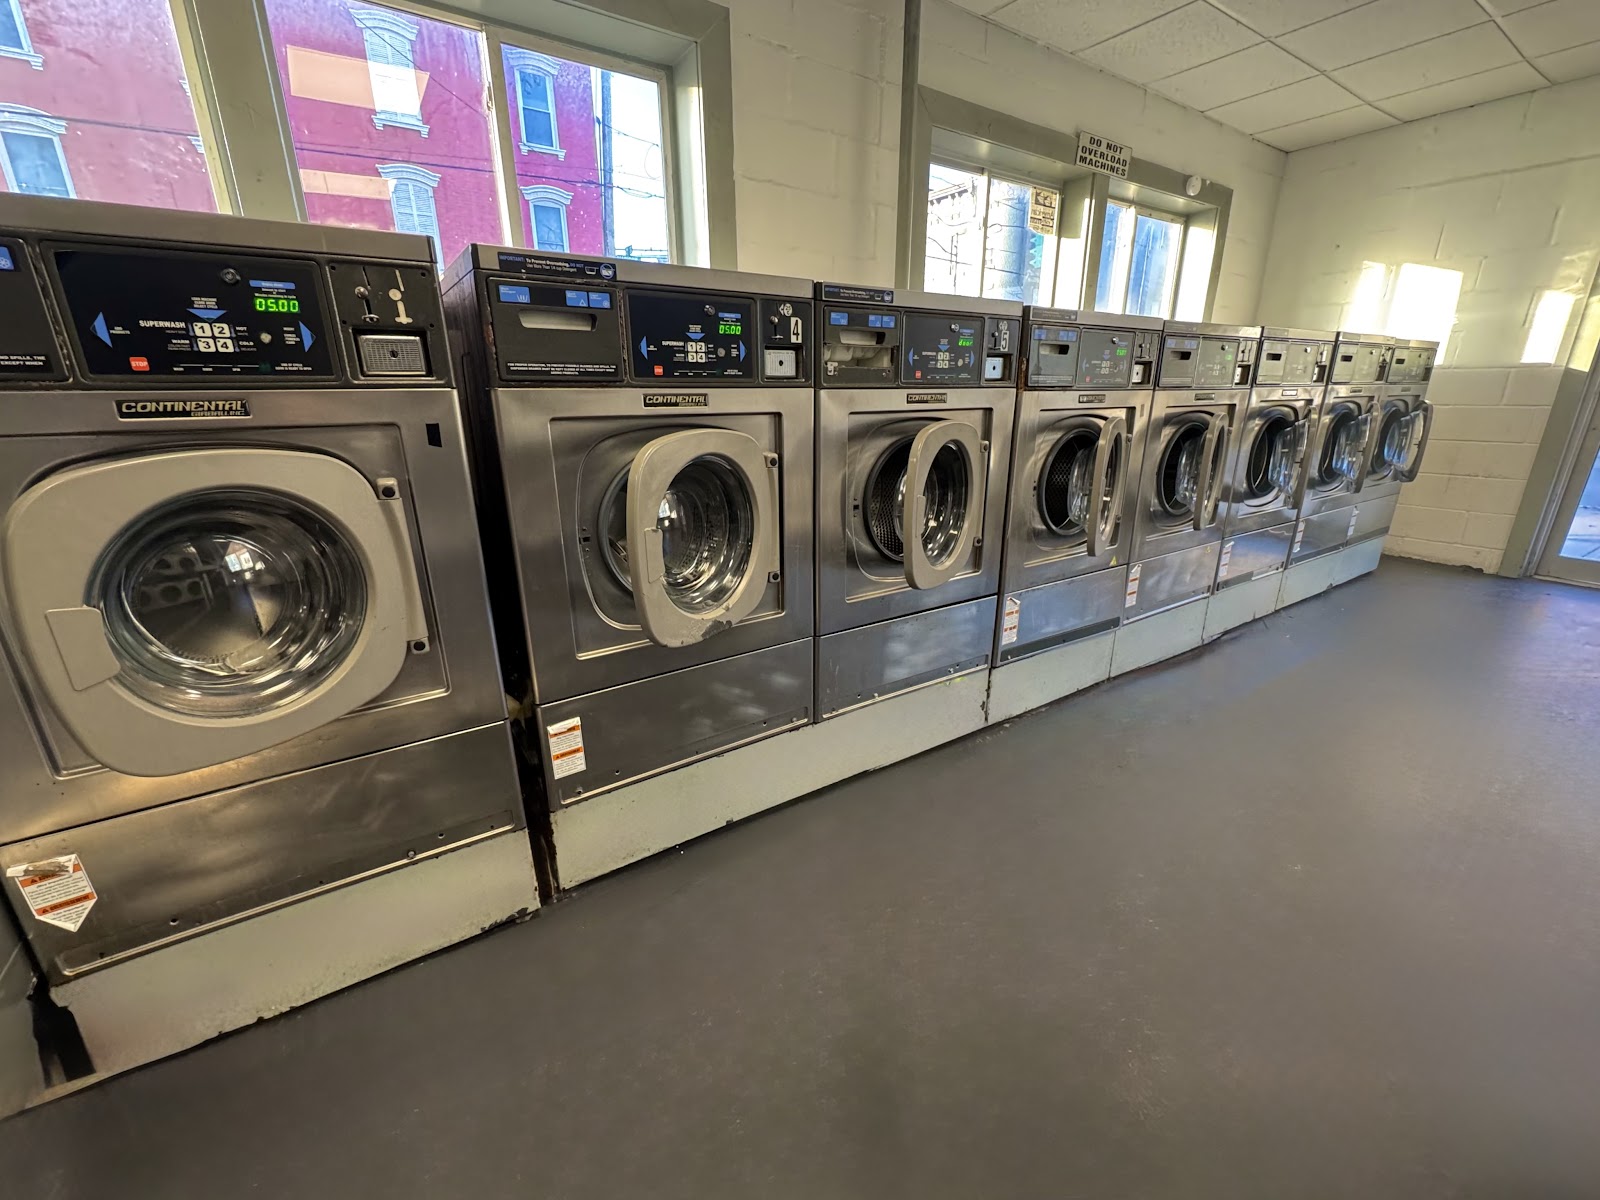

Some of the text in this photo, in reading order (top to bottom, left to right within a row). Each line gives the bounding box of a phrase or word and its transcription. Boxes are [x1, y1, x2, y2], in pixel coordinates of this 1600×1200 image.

[1090, 136, 1123, 154] DO NOT
[1079, 155, 1126, 176] MACHINES
[1082, 146, 1127, 167] OVERLOAD
[256, 298, 298, 312] 05.00
[139, 320, 186, 328] SUPERWASH
[719, 325, 741, 334] 05.00
[793, 320, 800, 341] 4
[1002, 332, 1008, 350] 5
[122, 400, 244, 412] CONTINENTAL
